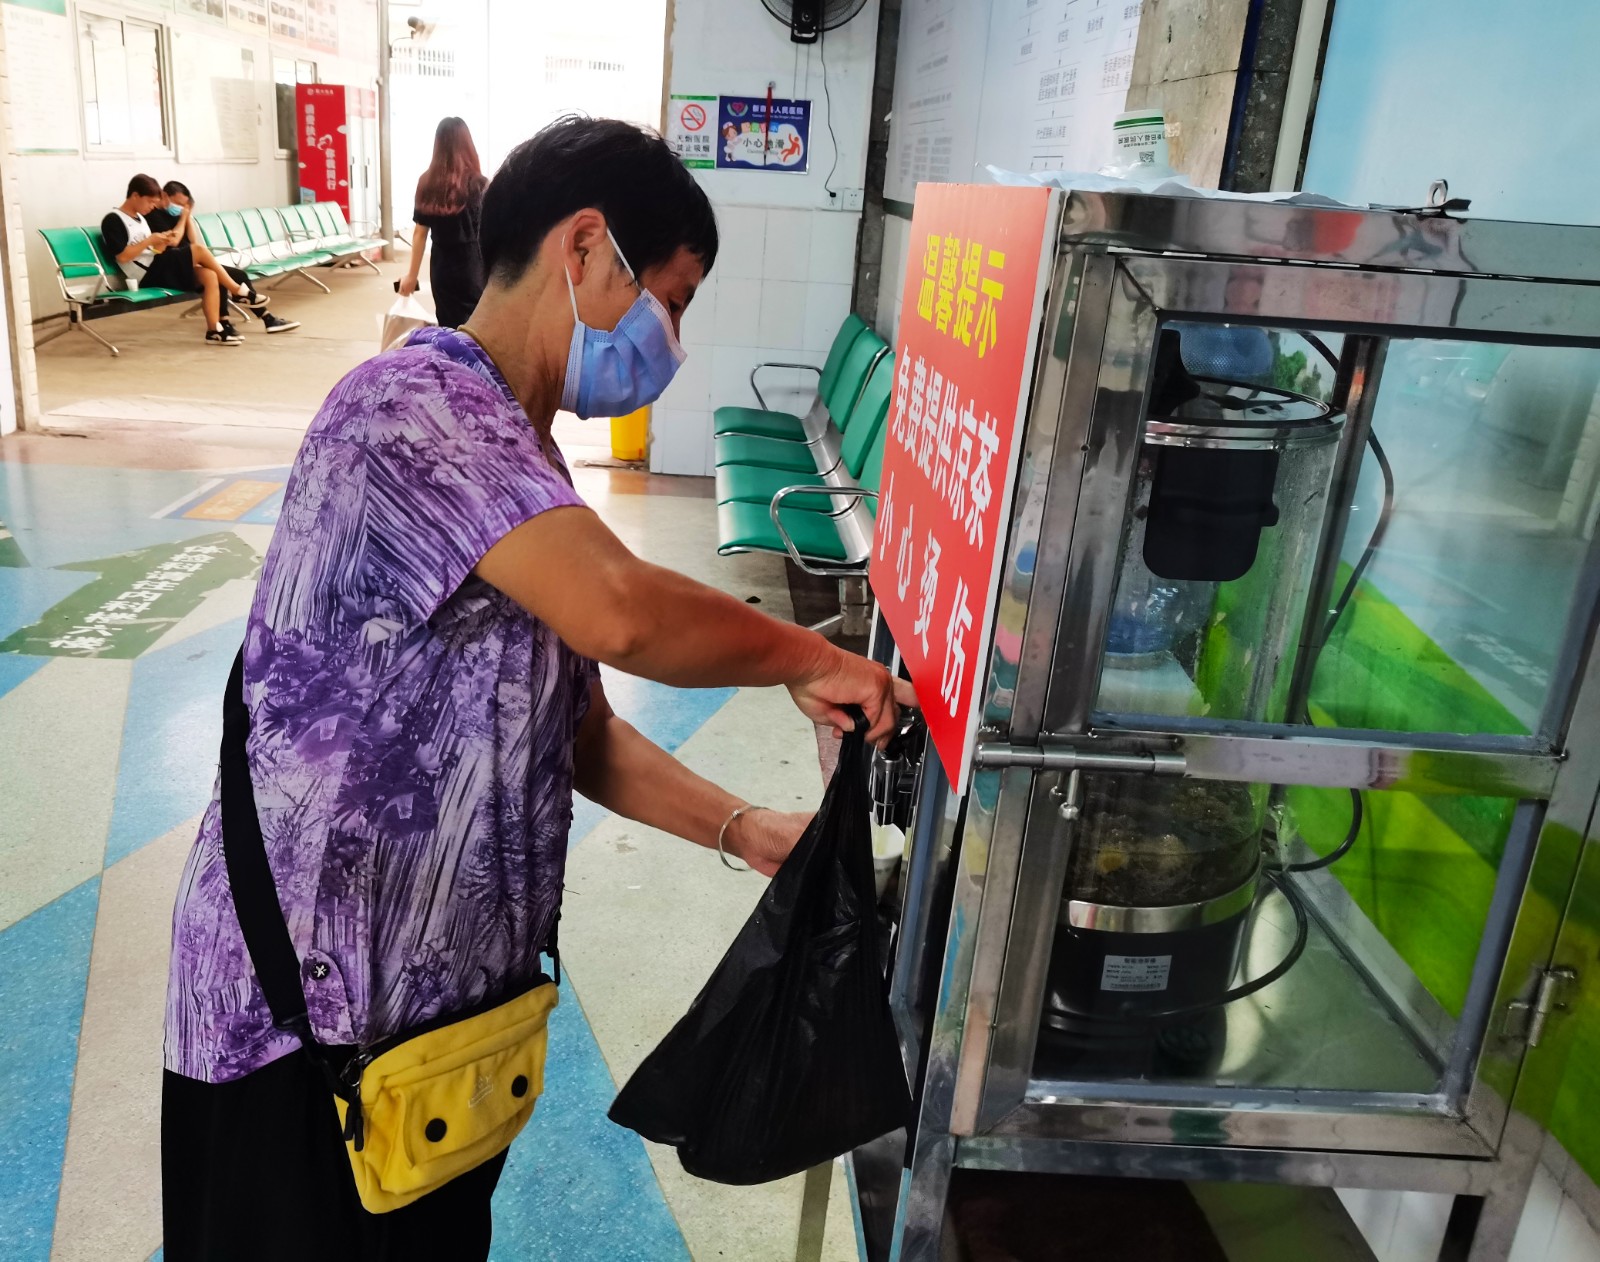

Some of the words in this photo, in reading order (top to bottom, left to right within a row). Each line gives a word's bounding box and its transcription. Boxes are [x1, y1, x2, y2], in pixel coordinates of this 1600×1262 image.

[916, 234, 1006, 358] 温馨提示
[892, 343, 1000, 552] 免费提供凉茶
[879, 471, 974, 720] 小心烫伤
